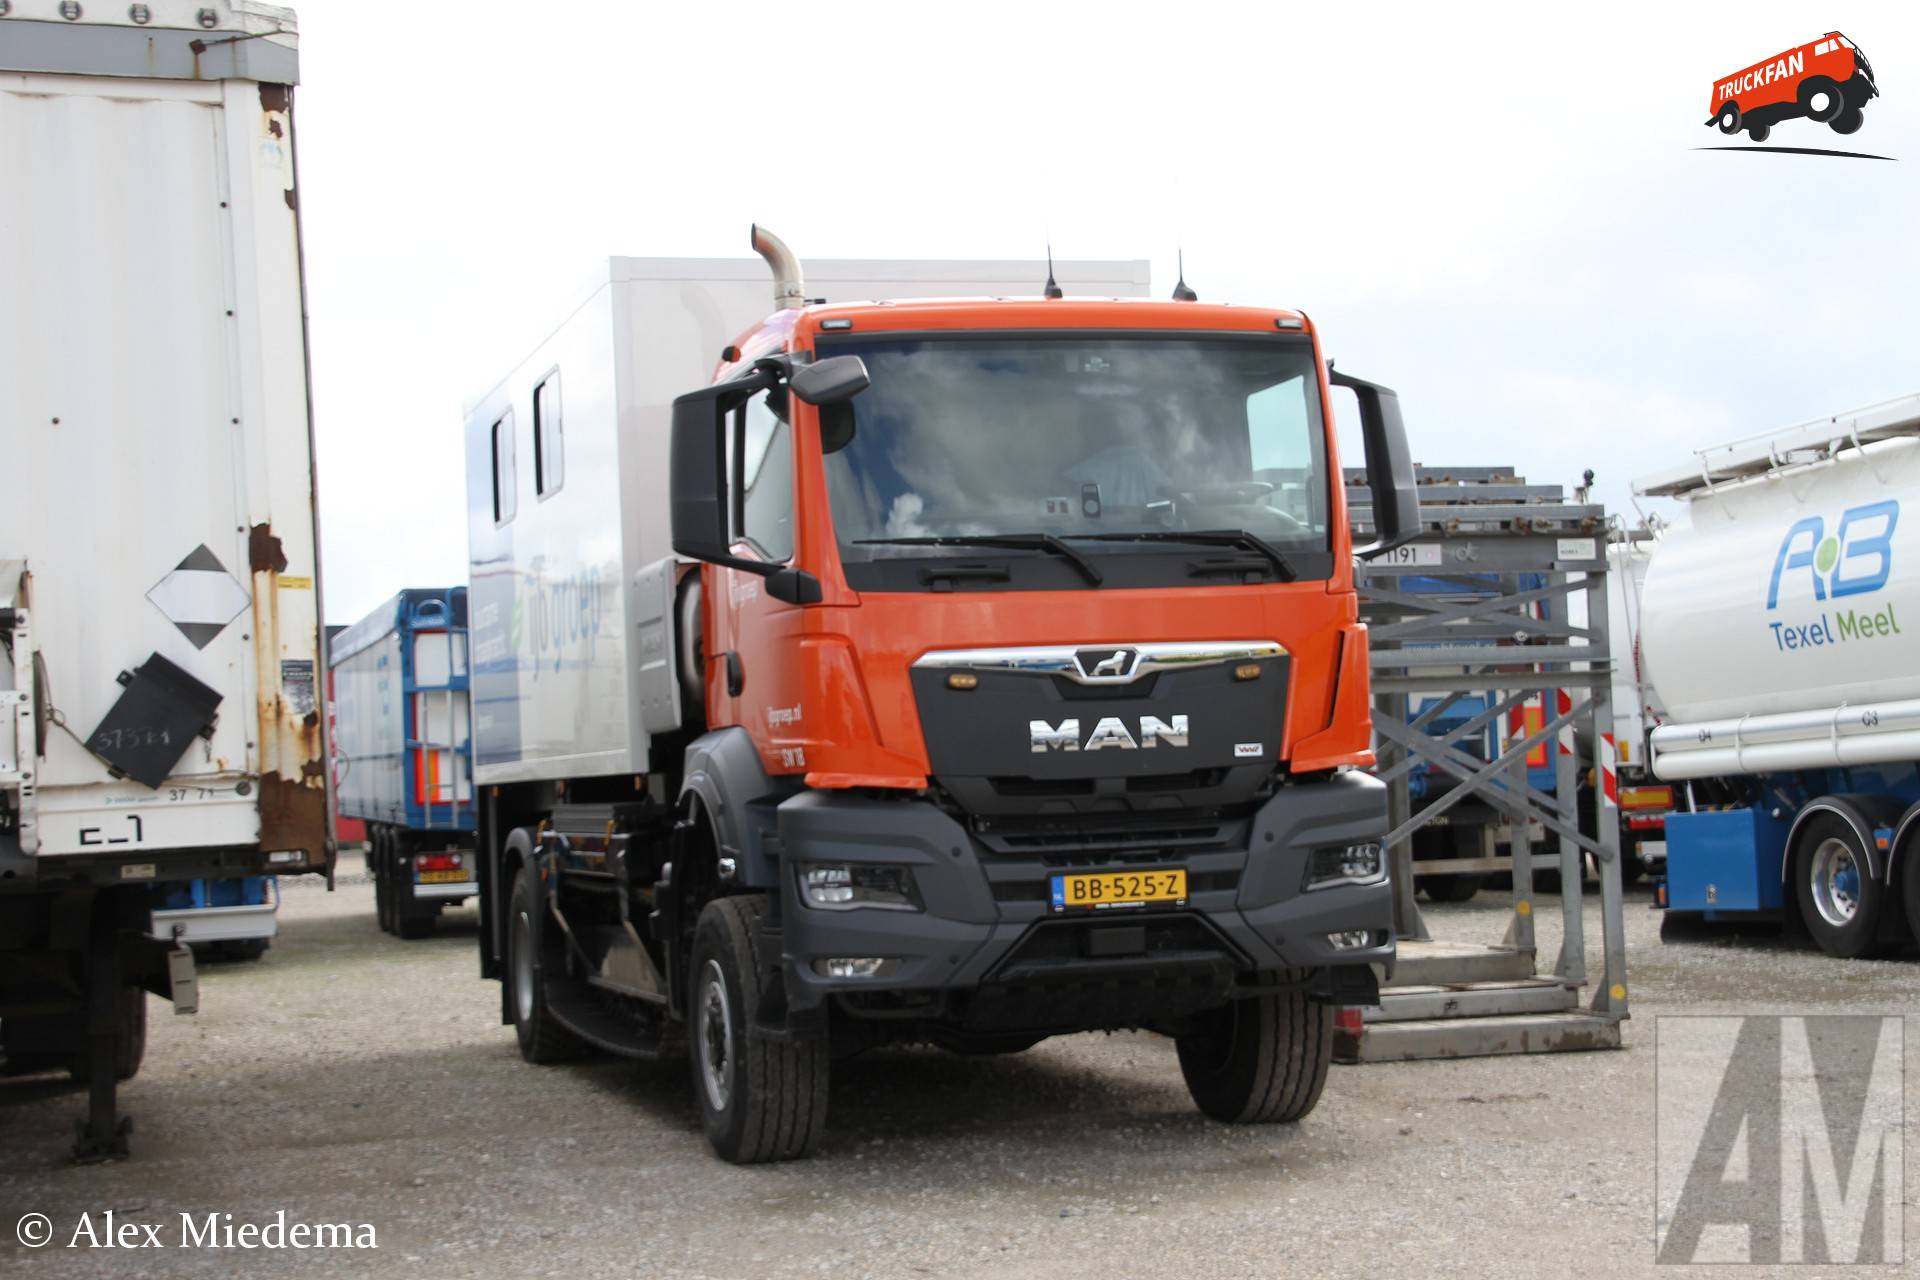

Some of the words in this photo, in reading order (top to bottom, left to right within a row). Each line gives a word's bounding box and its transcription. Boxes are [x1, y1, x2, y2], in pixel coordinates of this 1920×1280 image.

[1769, 613, 1834, 651] Texel
[1835, 602, 1900, 642] Meel
[1029, 714, 1189, 753] MAN
[1073, 874, 1179, 900] BB-525-Z
